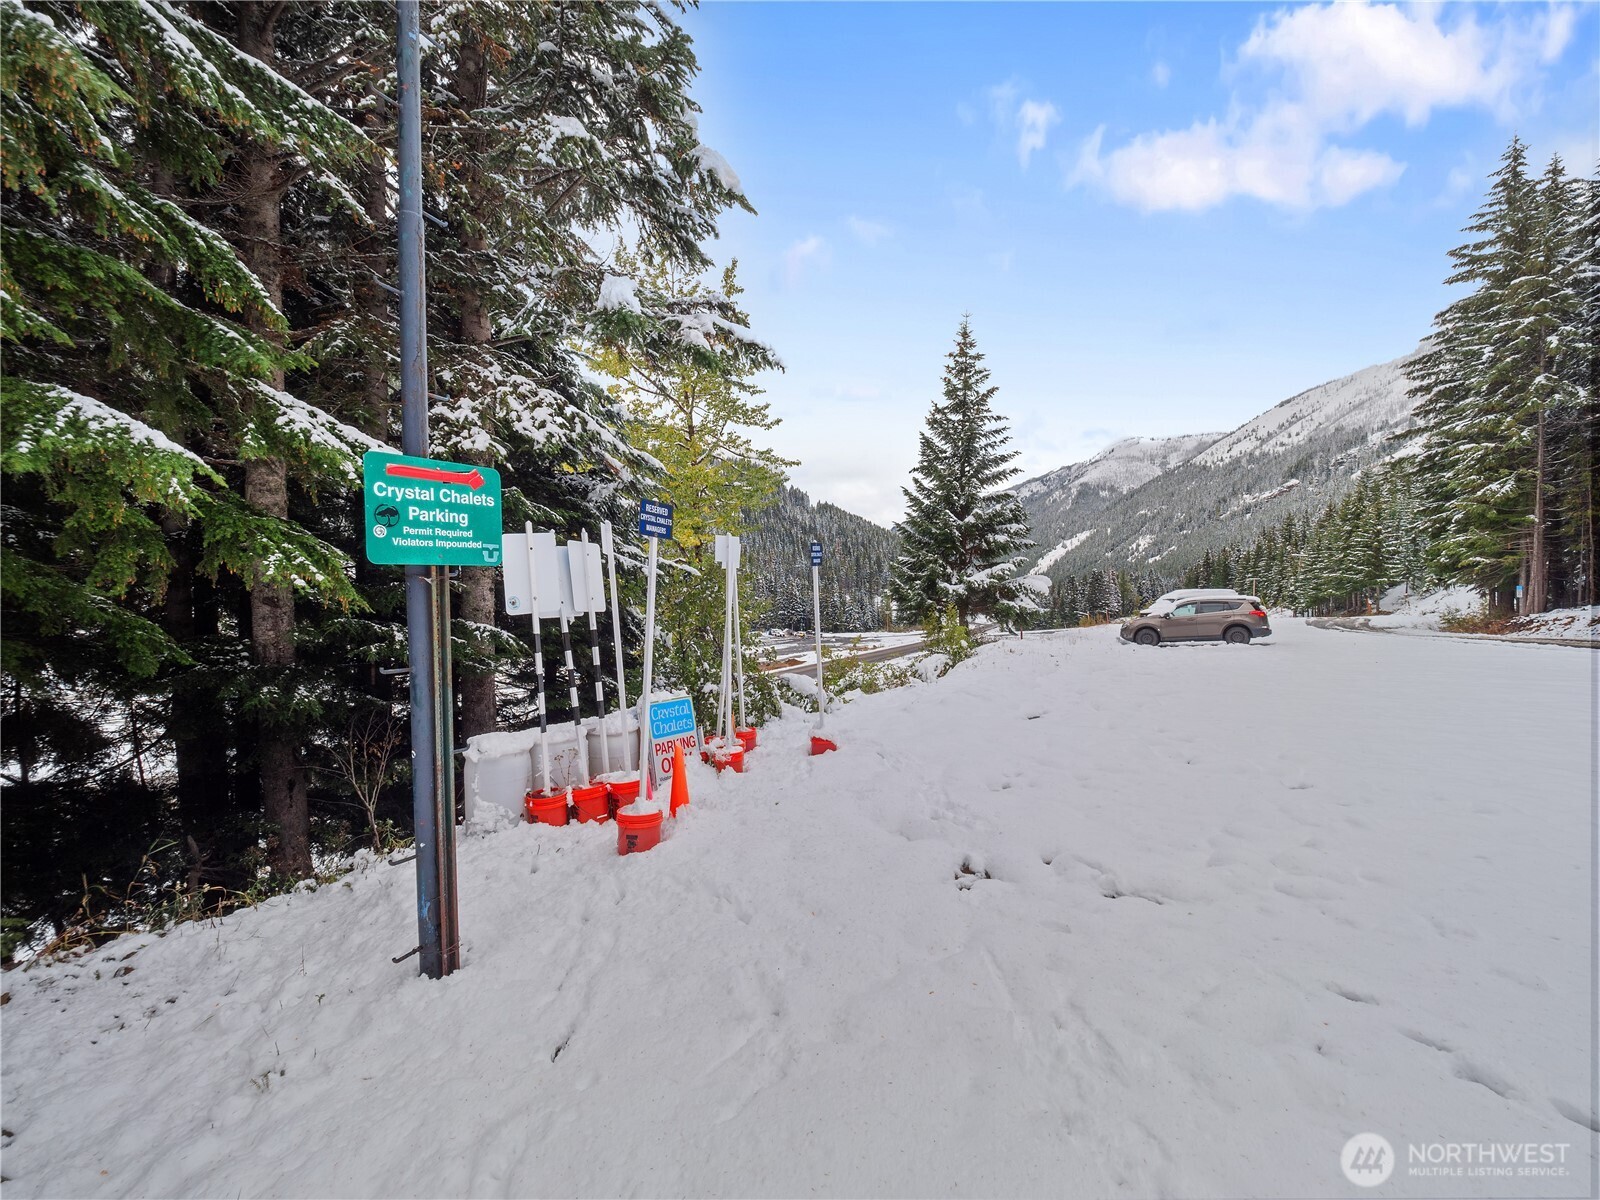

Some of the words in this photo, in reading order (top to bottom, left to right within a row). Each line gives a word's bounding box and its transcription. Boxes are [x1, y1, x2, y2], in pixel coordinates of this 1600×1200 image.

[373, 481, 434, 502] Crystal
[439, 488, 495, 507] Chalets
[646, 504, 668, 516] RESERVED
[408, 506, 469, 527] Parking
[641, 513, 656, 522] CRYSTAL
[657, 517, 672, 526] CHALETS
[403, 526, 433, 536] Permit
[435, 527, 473, 538] Required
[646, 524, 666, 534] MANAGERS
[392, 537, 434, 547] Violators
[435, 538, 482, 549] Impounded
[654, 719, 692, 735] Chalets
